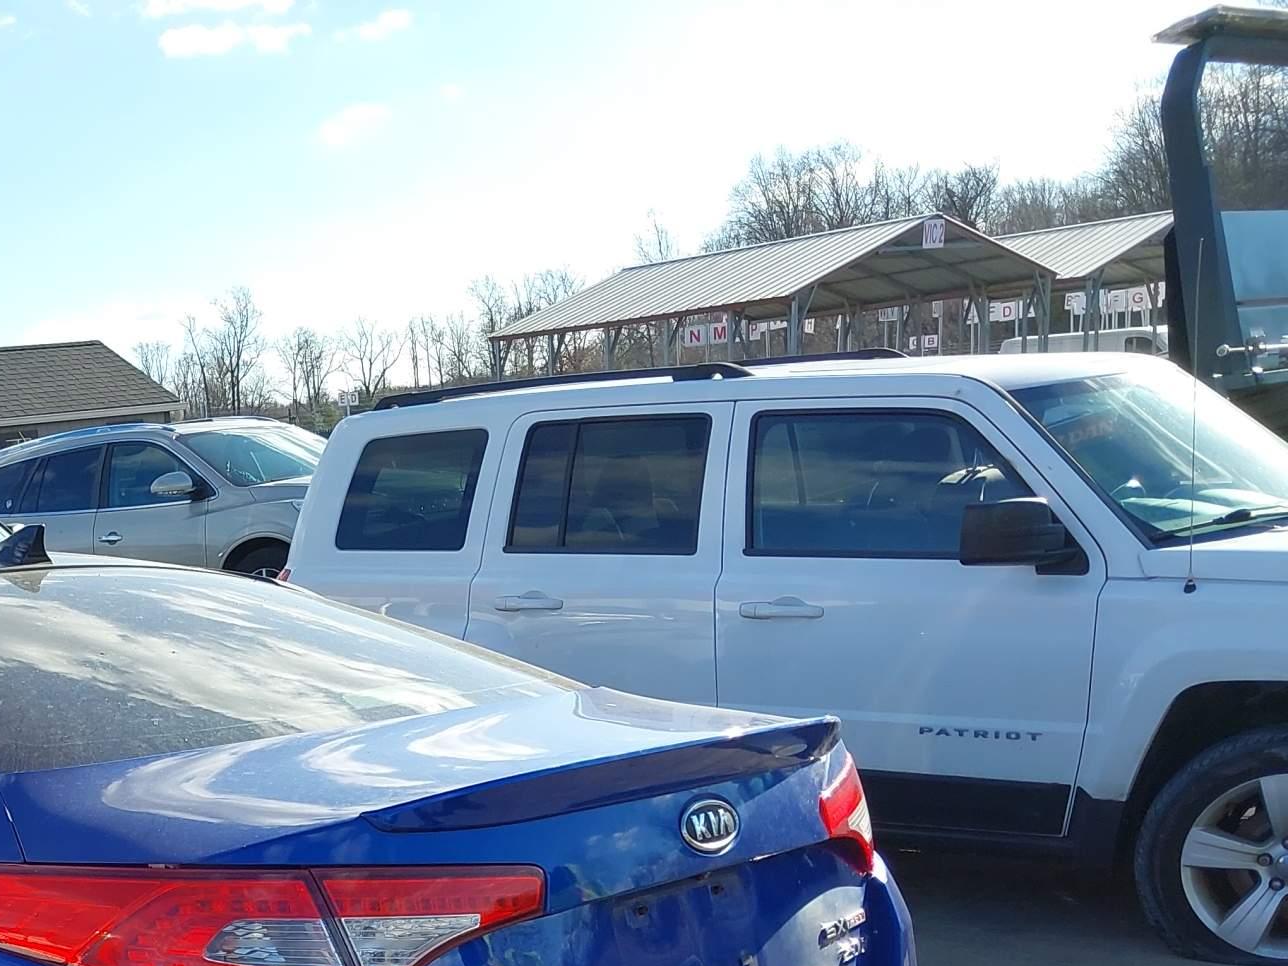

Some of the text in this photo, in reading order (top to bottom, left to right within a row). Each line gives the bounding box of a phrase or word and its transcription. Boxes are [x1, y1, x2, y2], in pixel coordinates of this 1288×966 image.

[1132, 292, 1144, 304] G
[1002, 306, 1012, 318] D
[689, 329, 701, 343] N
[713, 326, 727, 340] M
[919, 726, 1043, 742] PATRIOT
[690, 808, 735, 841] KIA
